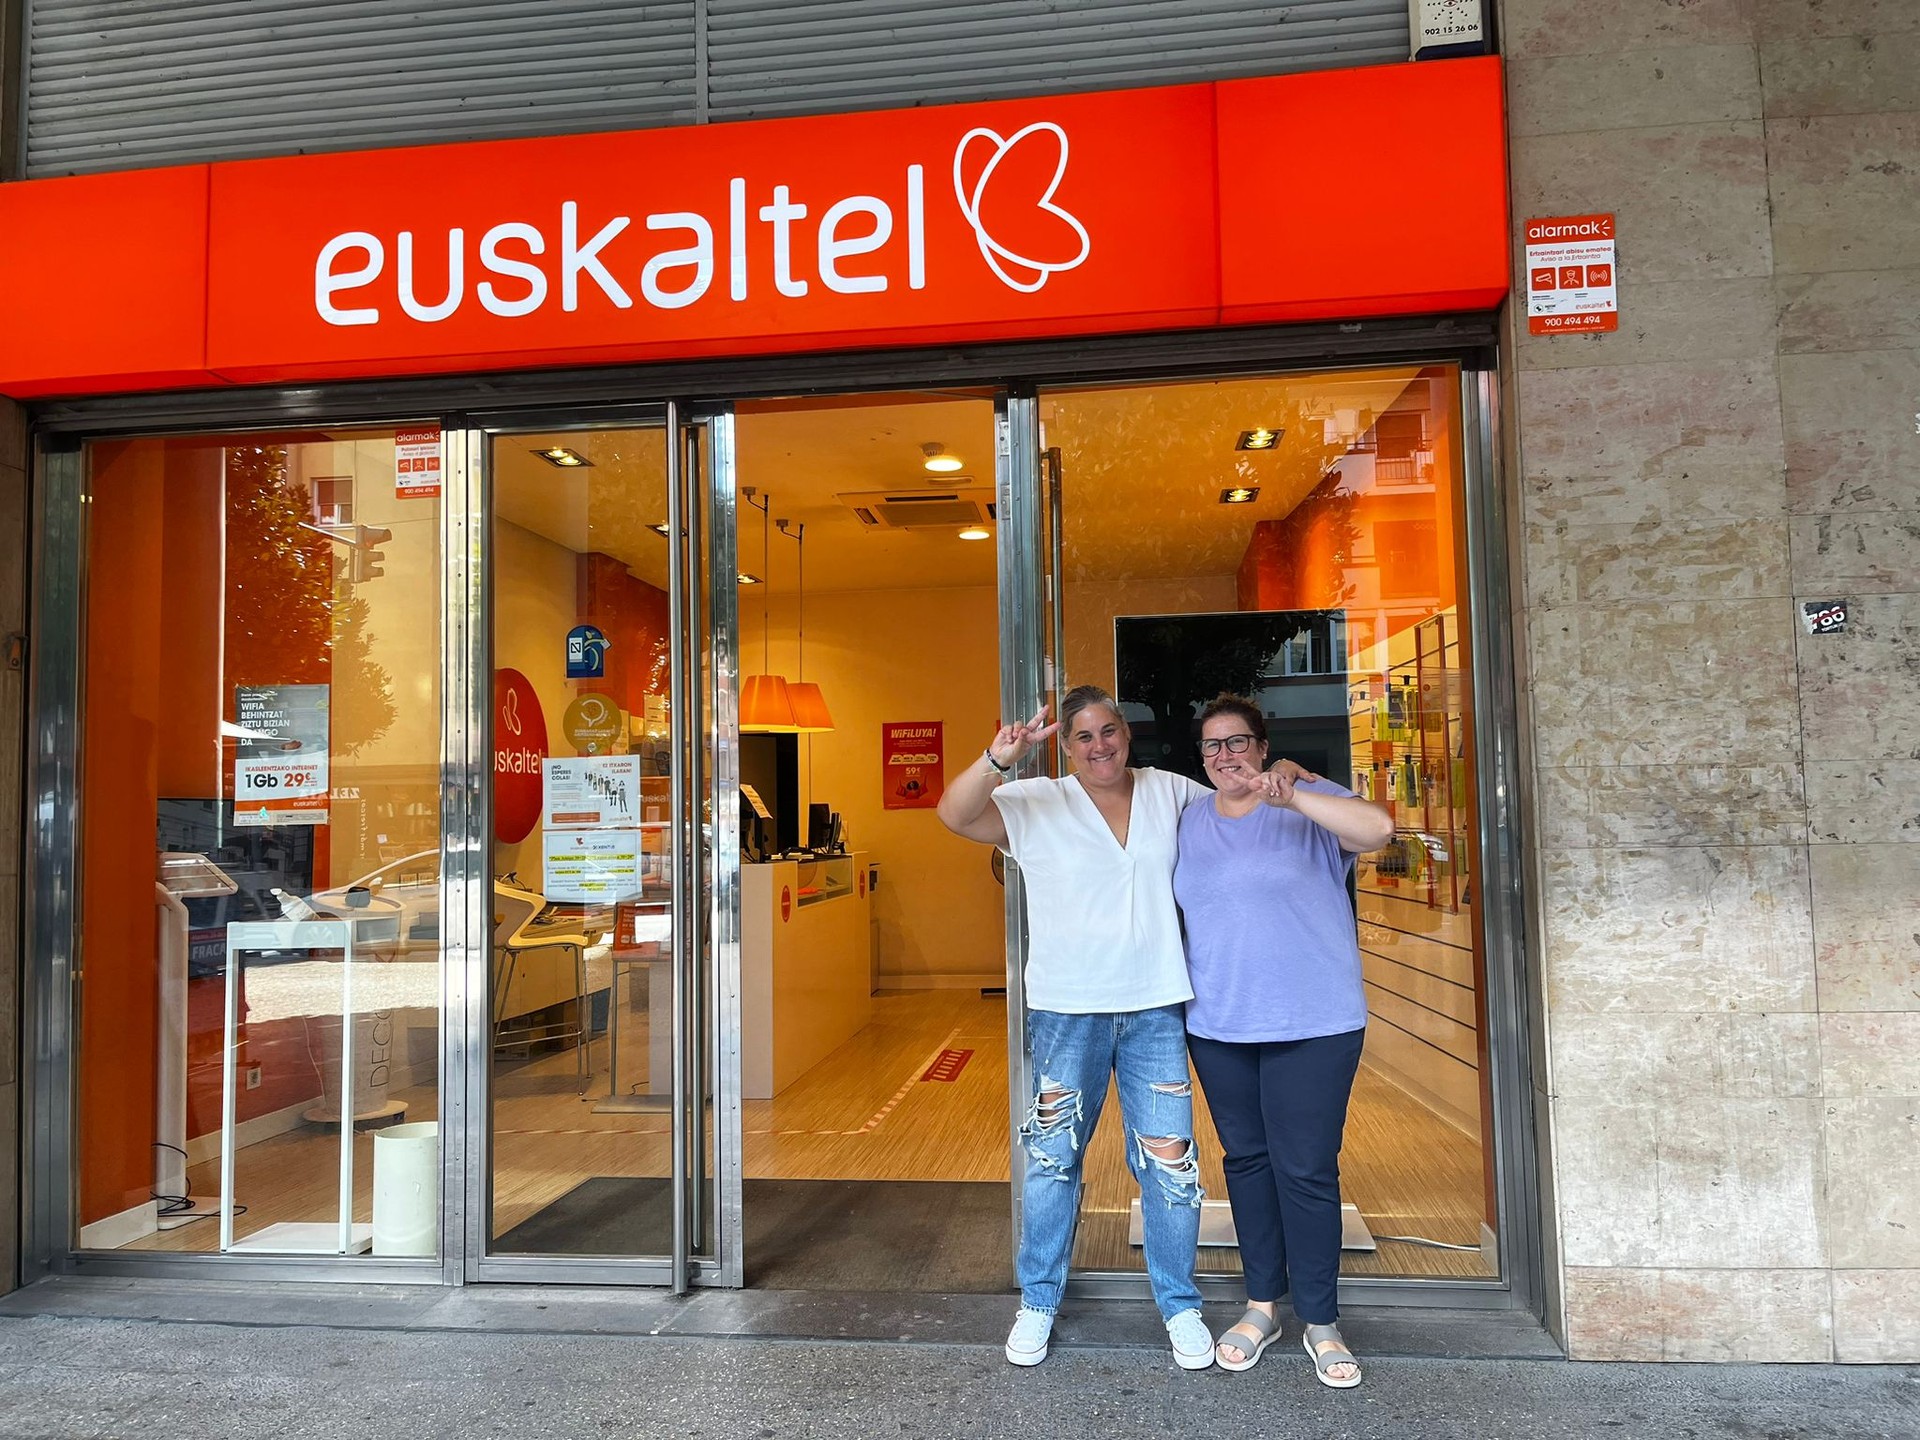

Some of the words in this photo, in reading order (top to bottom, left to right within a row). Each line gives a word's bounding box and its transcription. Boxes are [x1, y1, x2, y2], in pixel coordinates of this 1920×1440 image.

[1529, 221, 1600, 238] alarmak
[315, 164, 926, 326] euskaltel
[1544, 318, 1562, 327] 900
[1564, 316, 1581, 325] 494
[1583, 315, 1600, 324] 494
[396, 432, 435, 442] alarmak
[241, 702, 264, 710] WIFIA
[241, 711, 284, 719] BEHINTZAT
[263, 719, 290, 727] BIZIAN
[241, 738, 253, 746] DA
[245, 773, 278, 788] 1Gb
